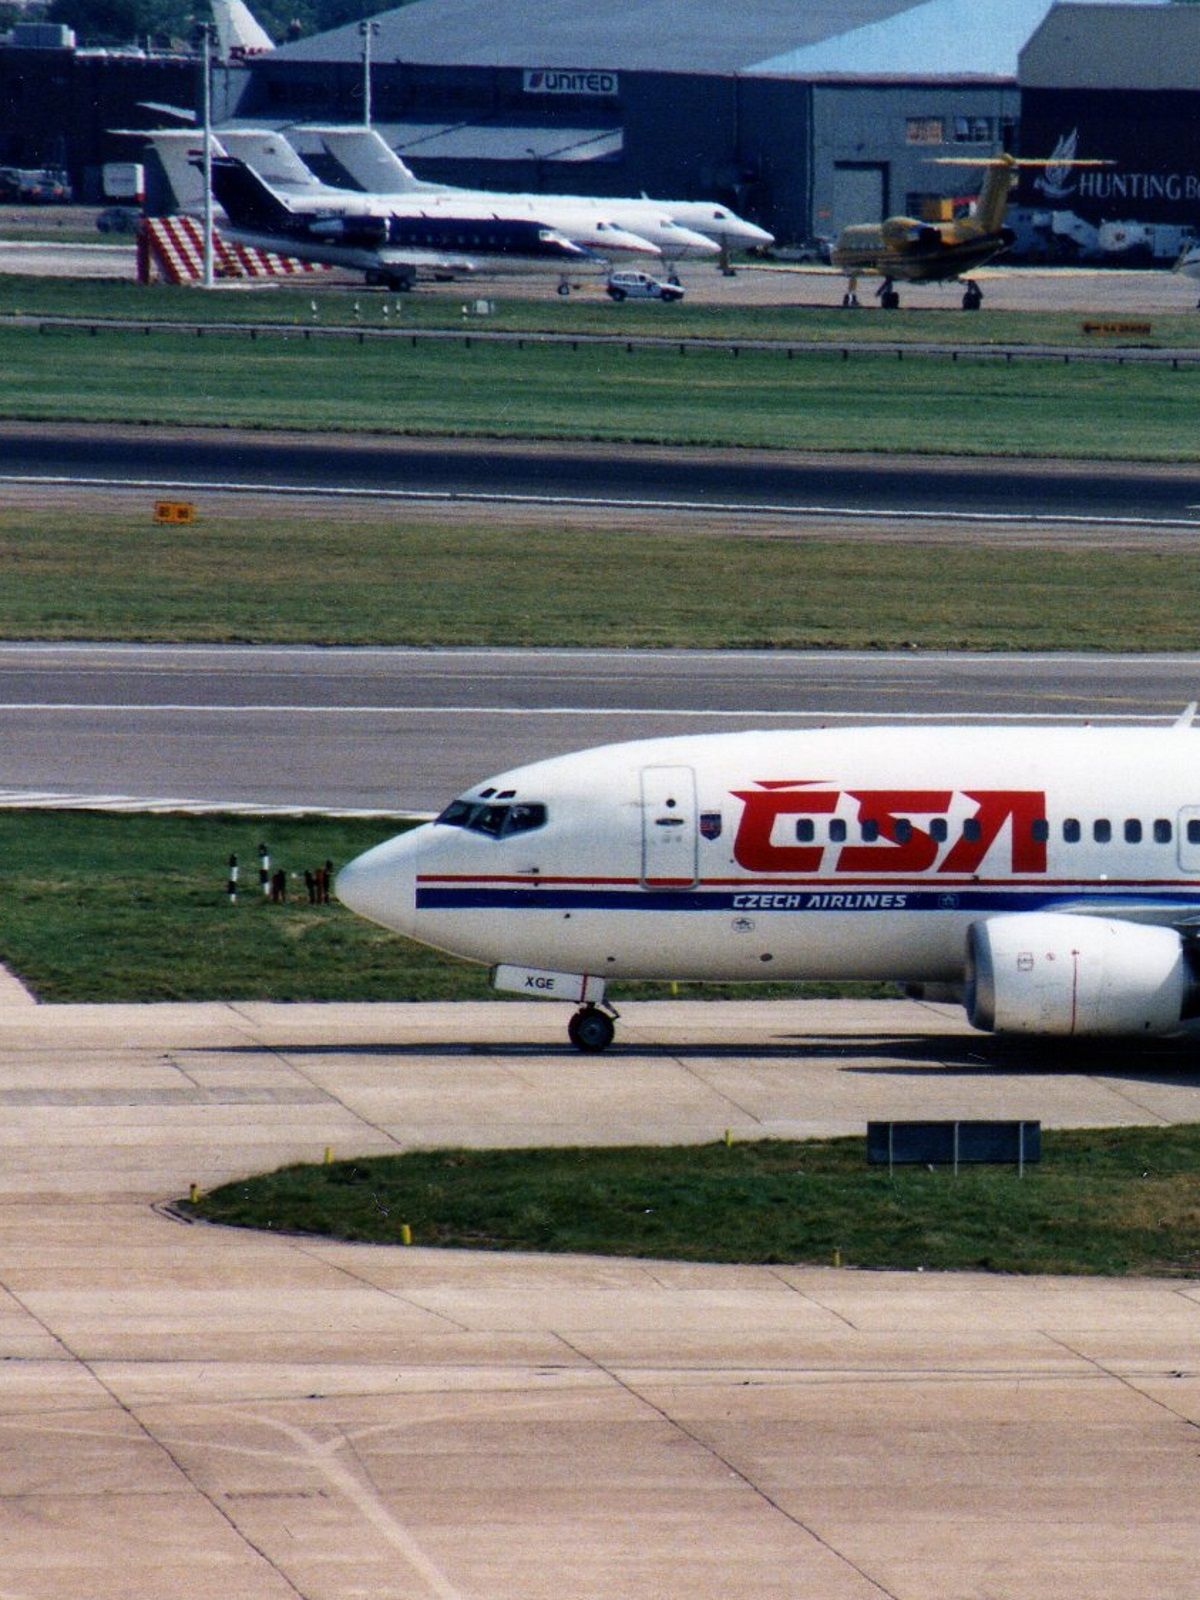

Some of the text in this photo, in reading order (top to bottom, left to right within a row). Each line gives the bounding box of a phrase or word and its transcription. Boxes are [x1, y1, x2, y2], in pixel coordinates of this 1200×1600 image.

[545, 73, 614, 92] UNITED
[1079, 173, 1181, 200] HUNTING
[733, 894, 907, 908] CZECH AIRLINES
[524, 976, 555, 990] XGE
